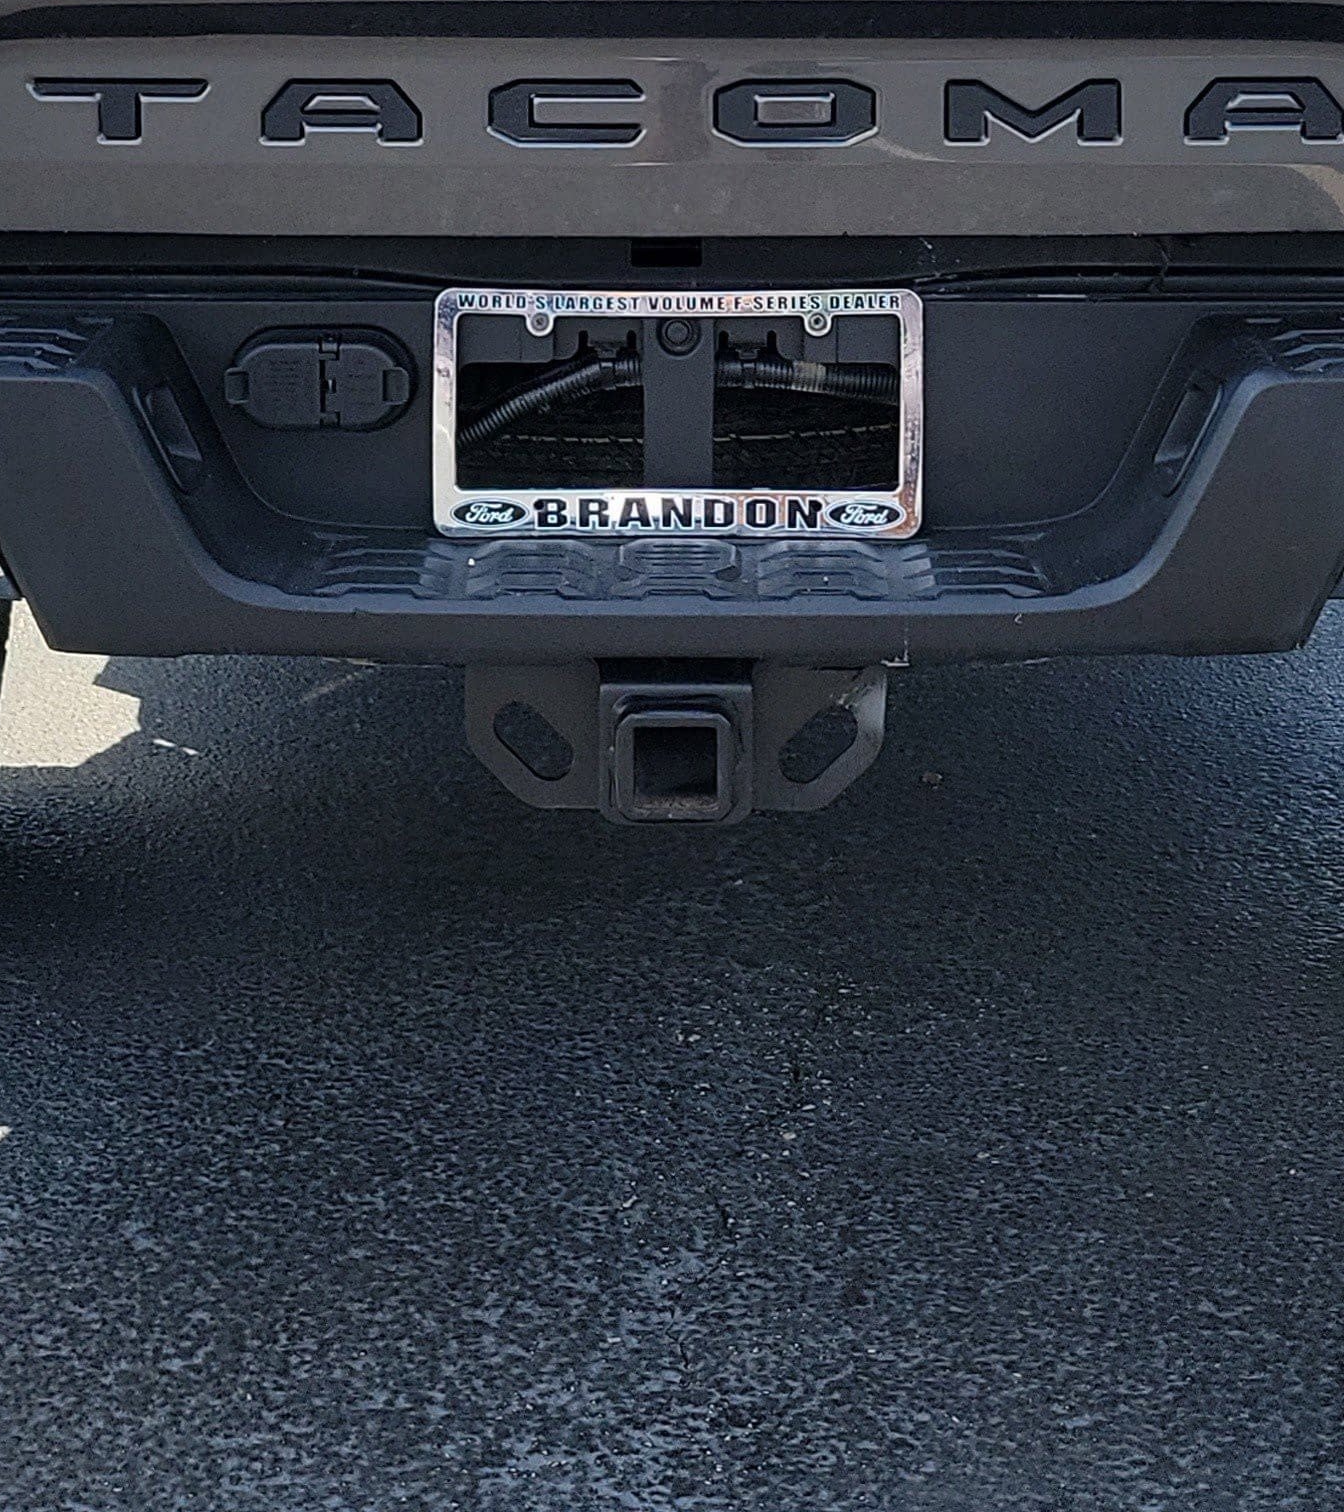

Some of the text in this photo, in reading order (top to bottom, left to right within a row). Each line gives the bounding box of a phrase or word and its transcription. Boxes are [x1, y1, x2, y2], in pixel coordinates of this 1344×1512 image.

[554, 295, 639, 311] LARGEST
[648, 295, 725, 311] VOLUME
[733, 294, 822, 311] F-SERIES
[829, 294, 900, 310] DEALER
[465, 496, 888, 529] Ford BRANDON Ford
